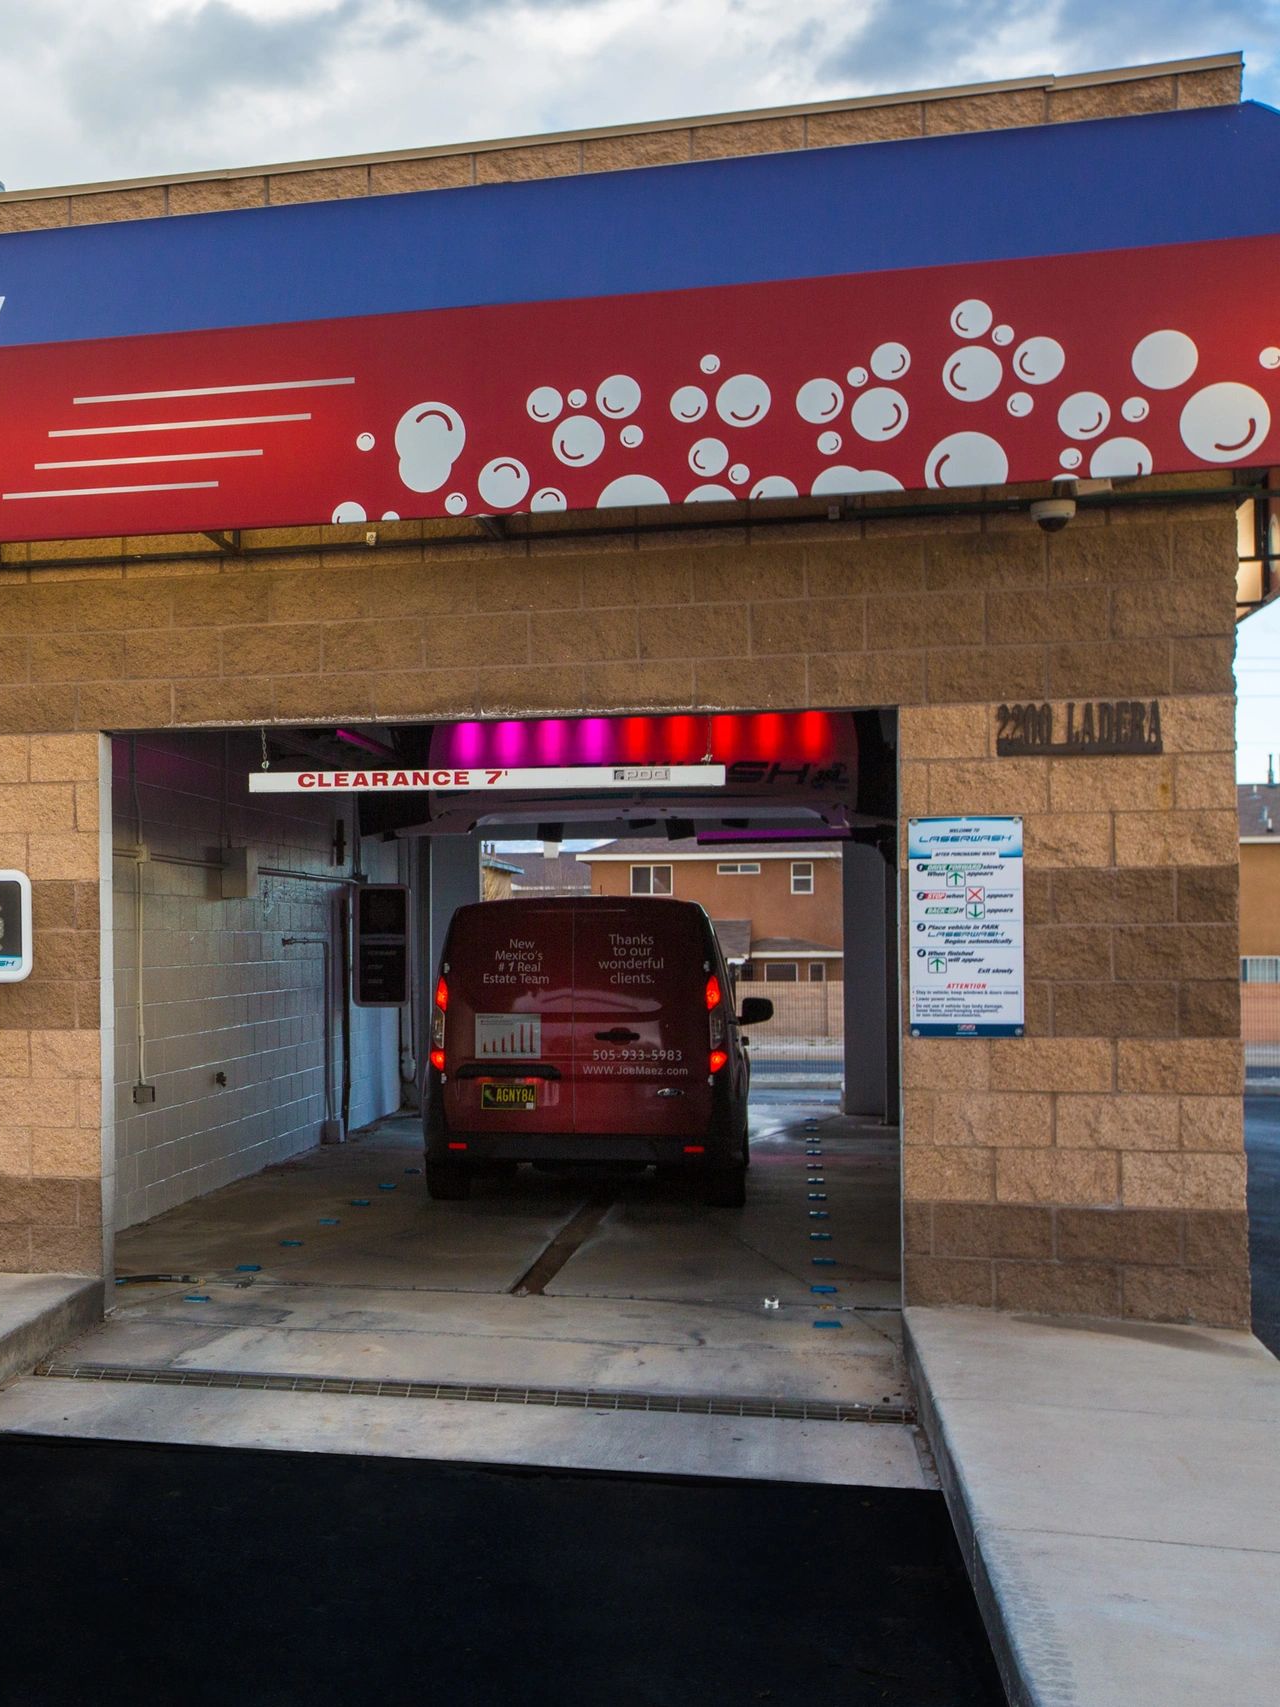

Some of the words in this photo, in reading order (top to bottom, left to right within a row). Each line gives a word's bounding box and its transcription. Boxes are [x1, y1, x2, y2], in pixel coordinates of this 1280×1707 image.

[1067, 699, 1163, 745] LADERA
[297, 770, 470, 788] CLEARANCE
[484, 770, 510, 785] 7'
[918, 834, 1012, 843] LASERWASH
[509, 938, 535, 949] New
[608, 933, 655, 945] Thanks
[495, 950, 544, 961] Mexico's
[613, 946, 627, 956] to
[629, 947, 653, 956] our
[517, 962, 541, 972] Real
[598, 957, 665, 969] wonderful
[482, 973, 517, 984] Estate
[521, 973, 550, 984] Team
[609, 972, 656, 984] clients.
[592, 1049, 683, 1061] 505-933-5983
